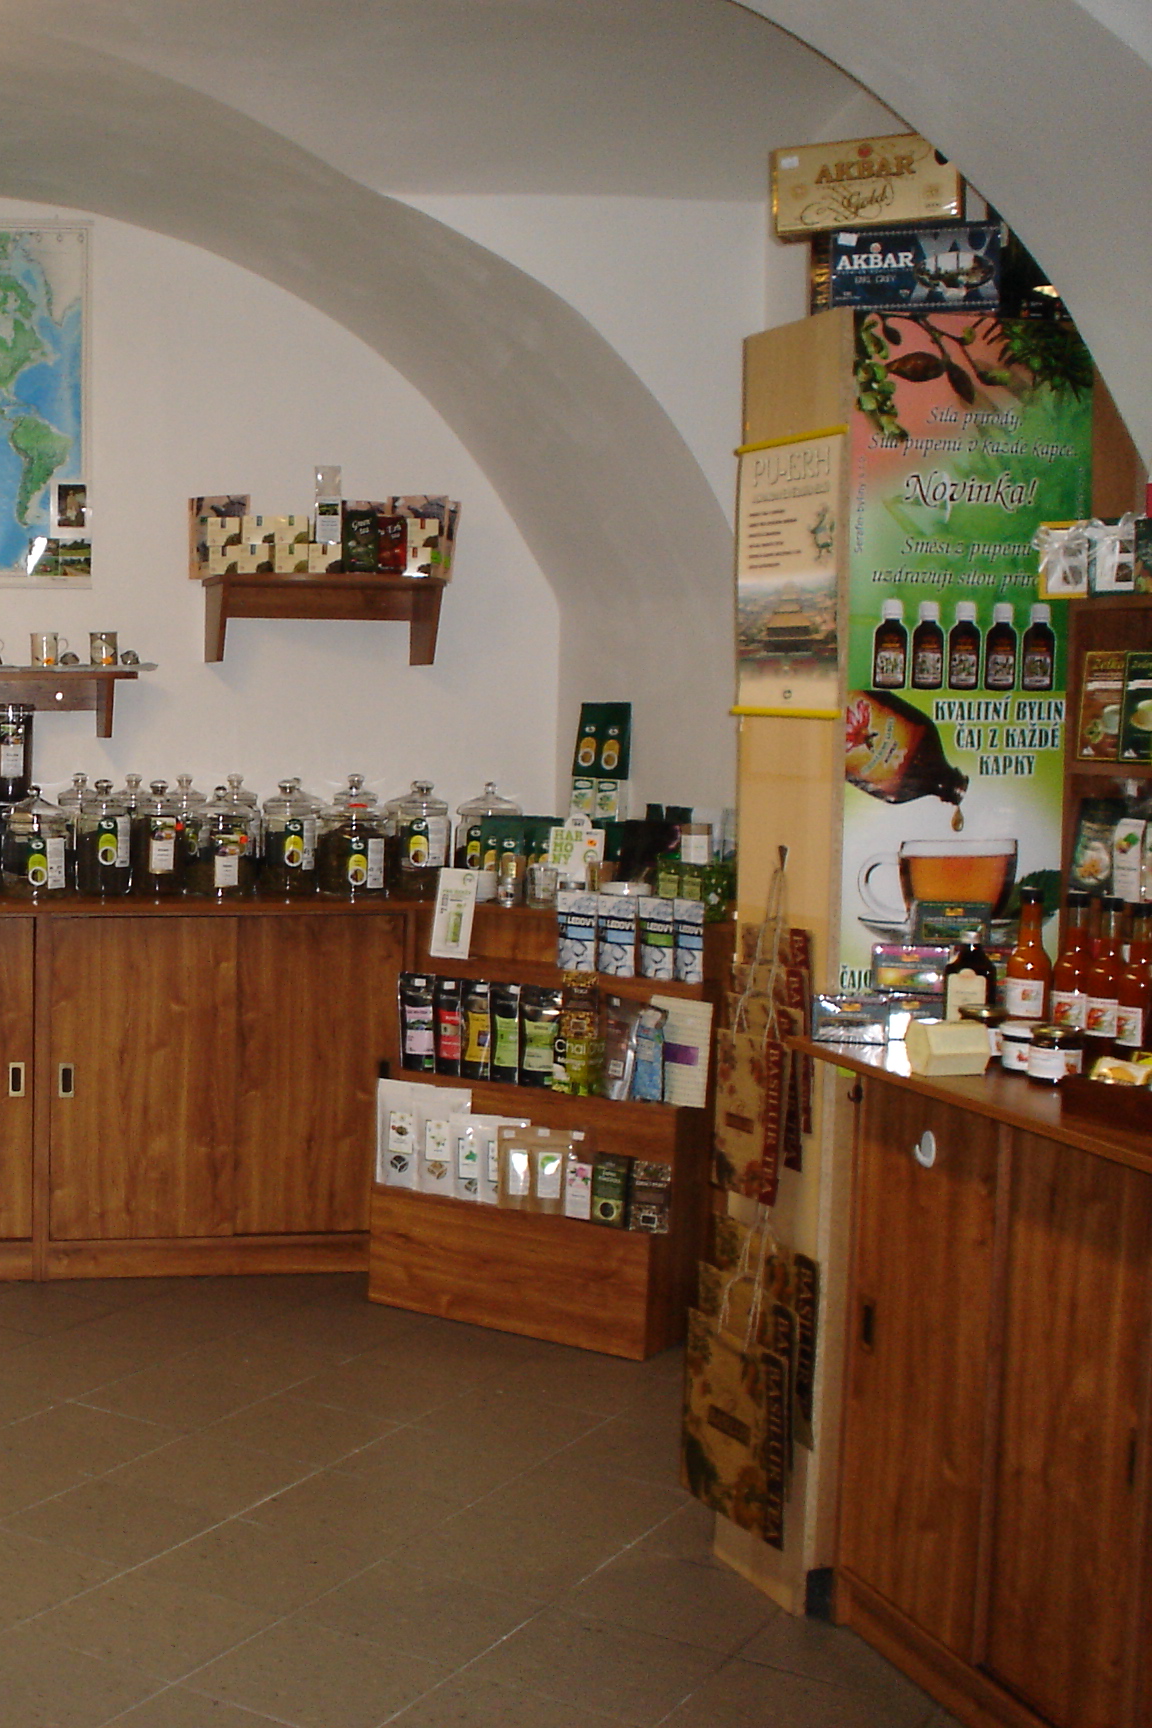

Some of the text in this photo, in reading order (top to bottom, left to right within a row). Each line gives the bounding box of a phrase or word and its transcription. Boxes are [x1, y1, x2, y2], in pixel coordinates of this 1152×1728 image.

[814, 155, 916, 185] AKBAR
[835, 251, 915, 271] AKBAR
[905, 471, 1038, 514] Novinka!
[934, 695, 1064, 721] KVALITNÍ BYLIN
[956, 723, 1060, 750] ČAJ Z KAŽDÉ
[979, 755, 1035, 775] KAPKY
[839, 965, 873, 991] ČAJO
[554, 1039, 586, 1056] Chai
